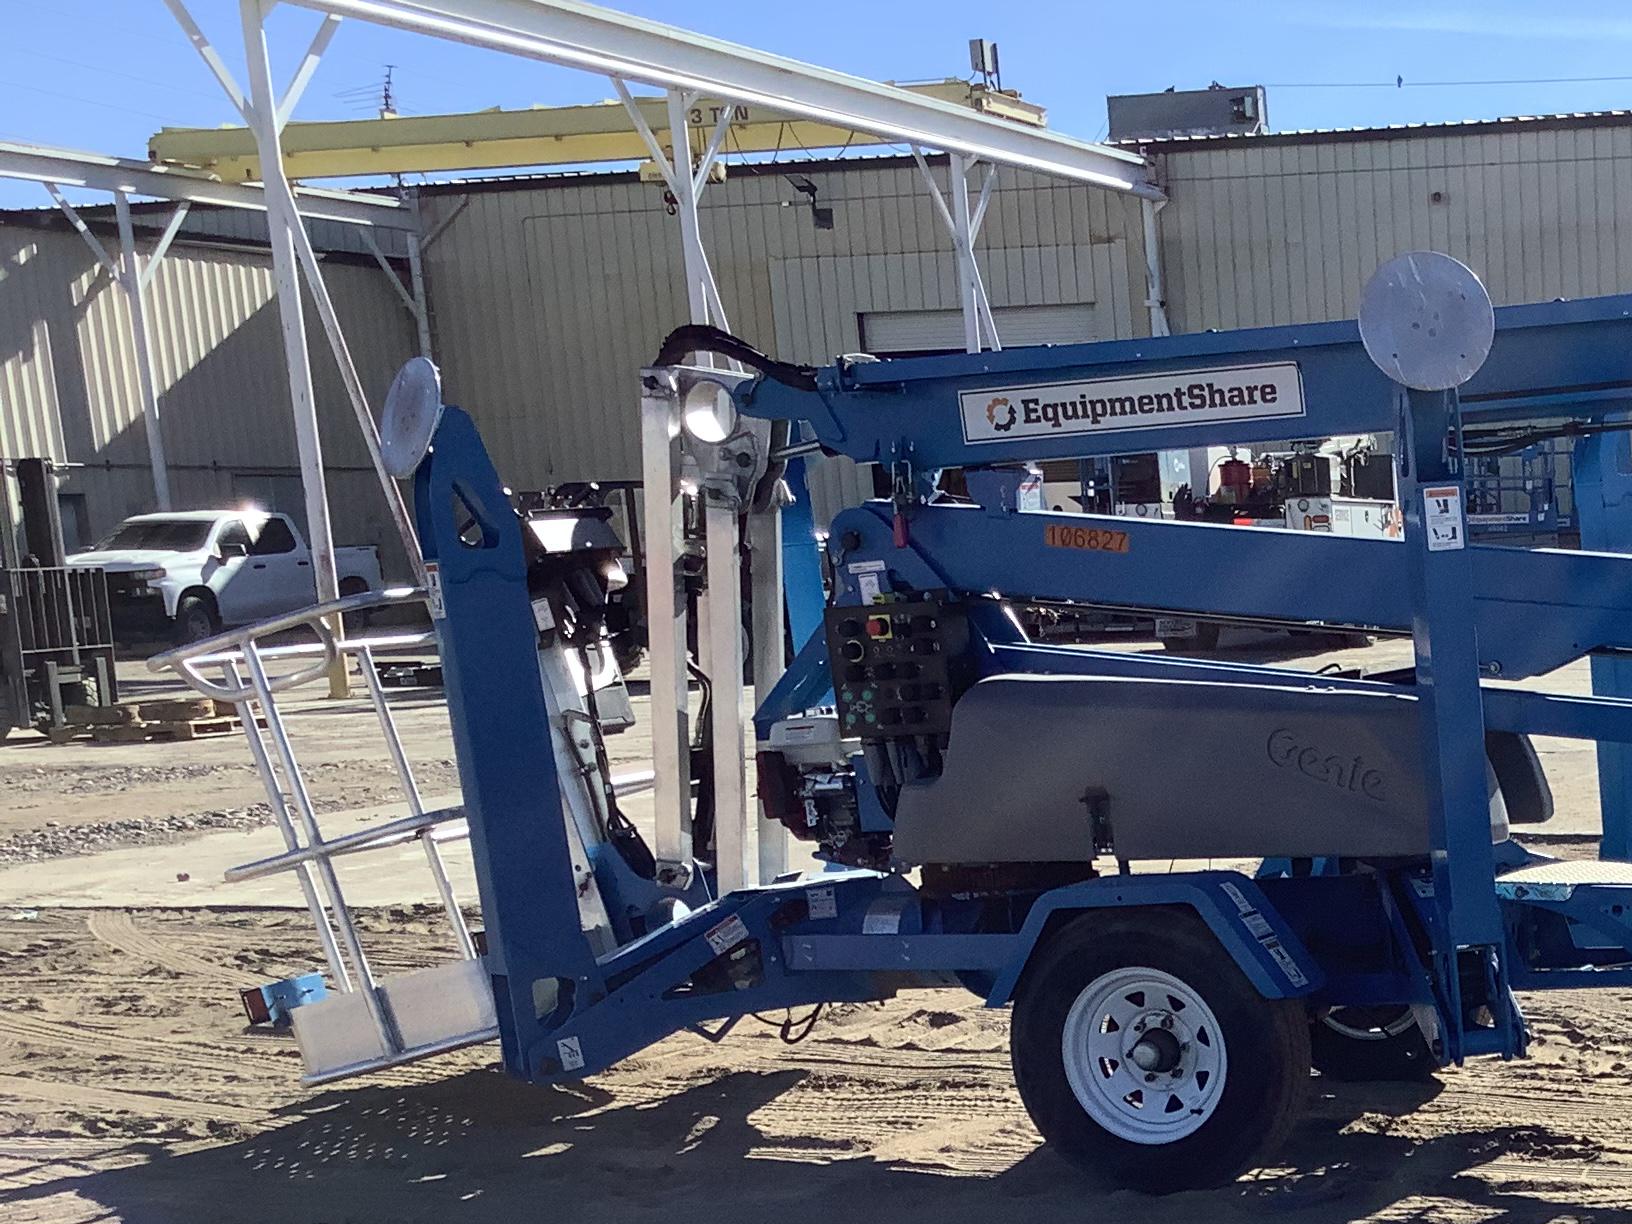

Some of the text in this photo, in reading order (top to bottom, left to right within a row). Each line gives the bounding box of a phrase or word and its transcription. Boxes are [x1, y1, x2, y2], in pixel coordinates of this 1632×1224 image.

[690, 105, 749, 124] 3 TN
[1021, 381, 1278, 428] EquipmentShare
[1048, 525, 1127, 551] 106827
[1266, 728, 1386, 801] Genie
